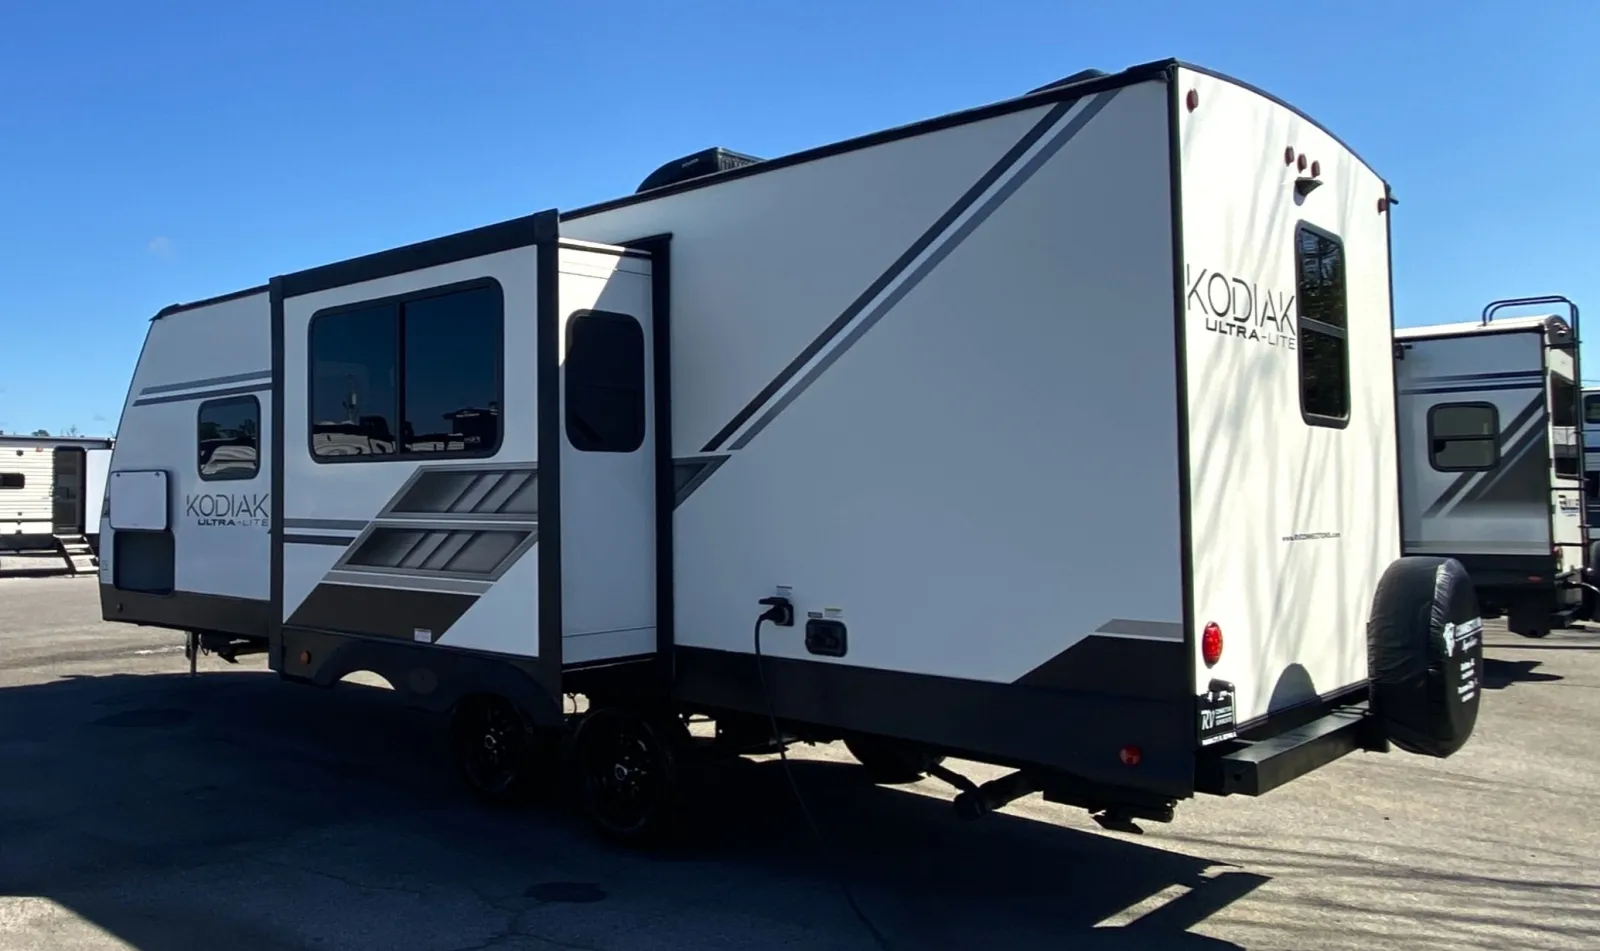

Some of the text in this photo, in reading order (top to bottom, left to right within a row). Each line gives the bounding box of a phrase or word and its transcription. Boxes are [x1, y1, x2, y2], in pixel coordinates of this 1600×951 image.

[1187, 263, 1296, 336] KODIAK
[1206, 318, 1296, 350] ULTRA-LITE
[186, 493, 269, 517] KODIAK
[197, 518, 269, 526] ULTRA-LITE
[1200, 709, 1215, 730] RV
